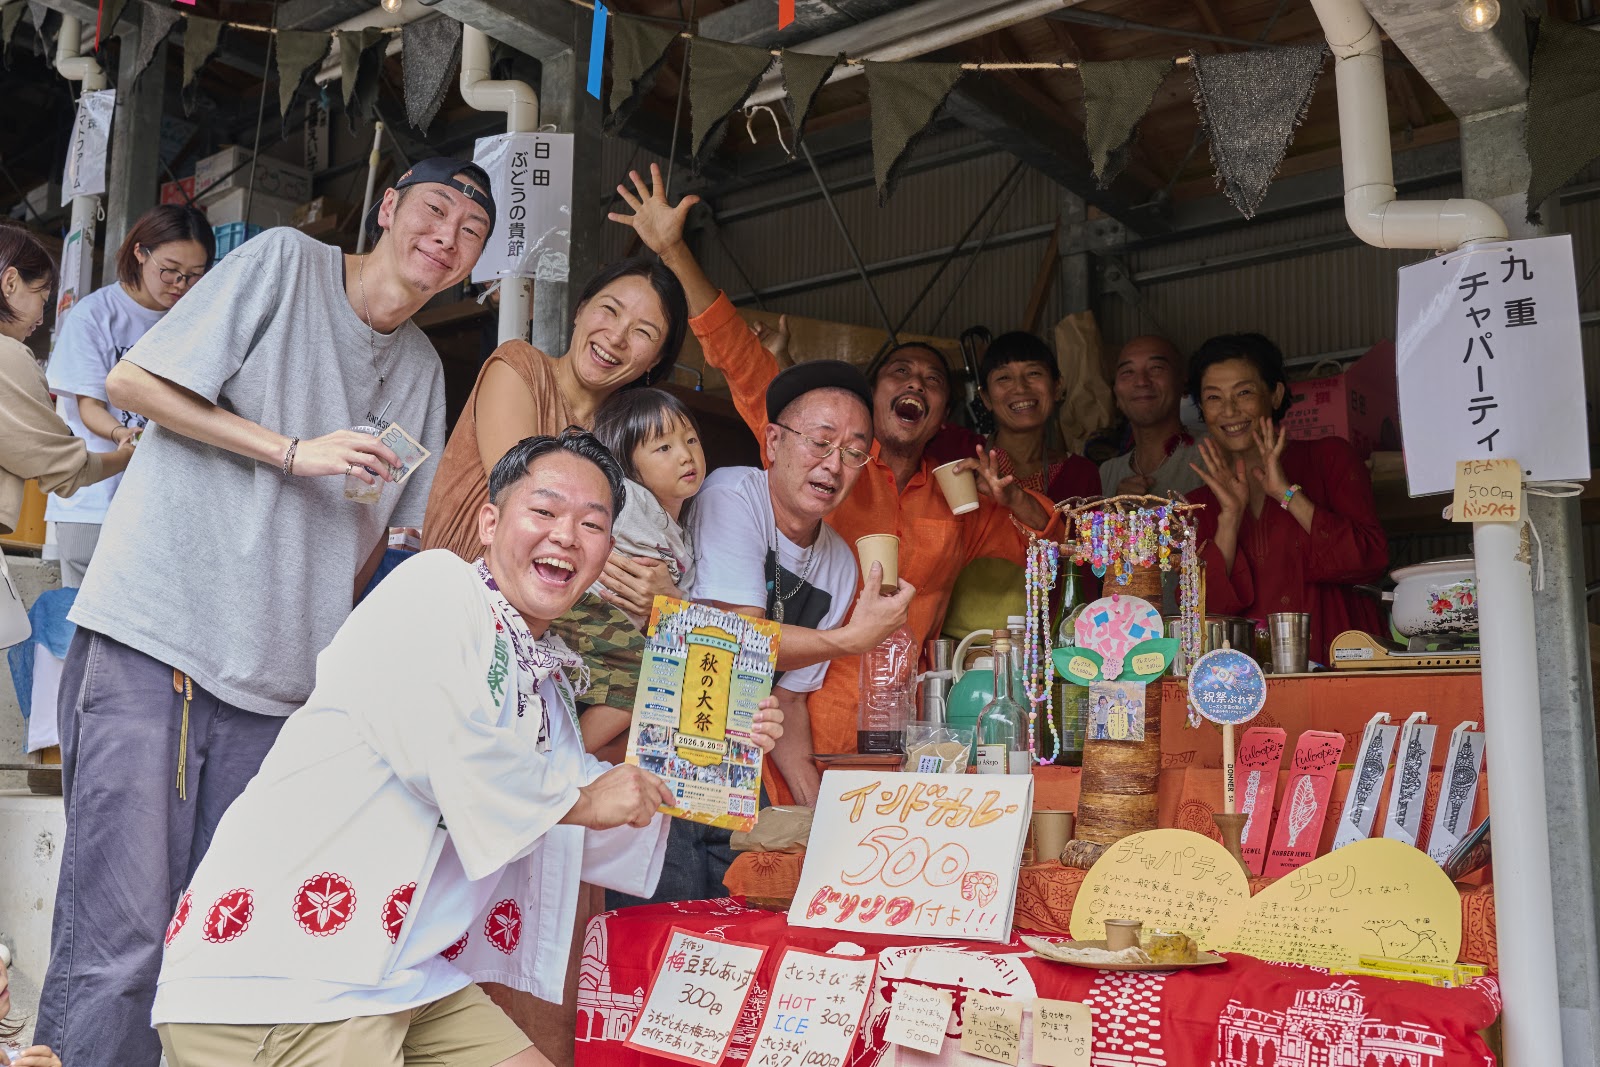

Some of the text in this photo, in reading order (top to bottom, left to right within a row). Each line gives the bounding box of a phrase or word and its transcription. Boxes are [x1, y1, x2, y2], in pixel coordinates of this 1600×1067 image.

[73, 103, 88, 189] トマトファーム
[533, 142, 549, 186] 日田
[508, 152, 528, 257] ぶどうの貴節
[1500, 255, 1538, 328] 九重
[1459, 271, 1500, 451] チャパーティ
[1468, 484, 1513, 500] 500円
[1463, 499, 1517, 519] ドリンク付
[694, 652, 718, 732] 秋の大祭
[678, 736, 716, 750] 2026.9.20
[840, 780, 1019, 828] インドカレー
[680, 938, 704, 952] 手作り
[1389, 940, 1409, 948] インド
[666, 950, 756, 992] 梅豆乳あいす
[678, 983, 722, 1015] 300円
[778, 993, 816, 1012] HOT
[902, 990, 941, 1007] ちょっぴり
[971, 998, 1006, 1017] ちょっぴり
[773, 1014, 809, 1034] ICE
[820, 1008, 855, 1037] 300円
[641, 1027, 720, 1060] で作ったあいすです
[760, 1036, 807, 1055] さとうきび
[906, 1028, 939, 1047] 500円
[800, 1050, 840, 1067] 1000円
[974, 1039, 1010, 1060] 500円
